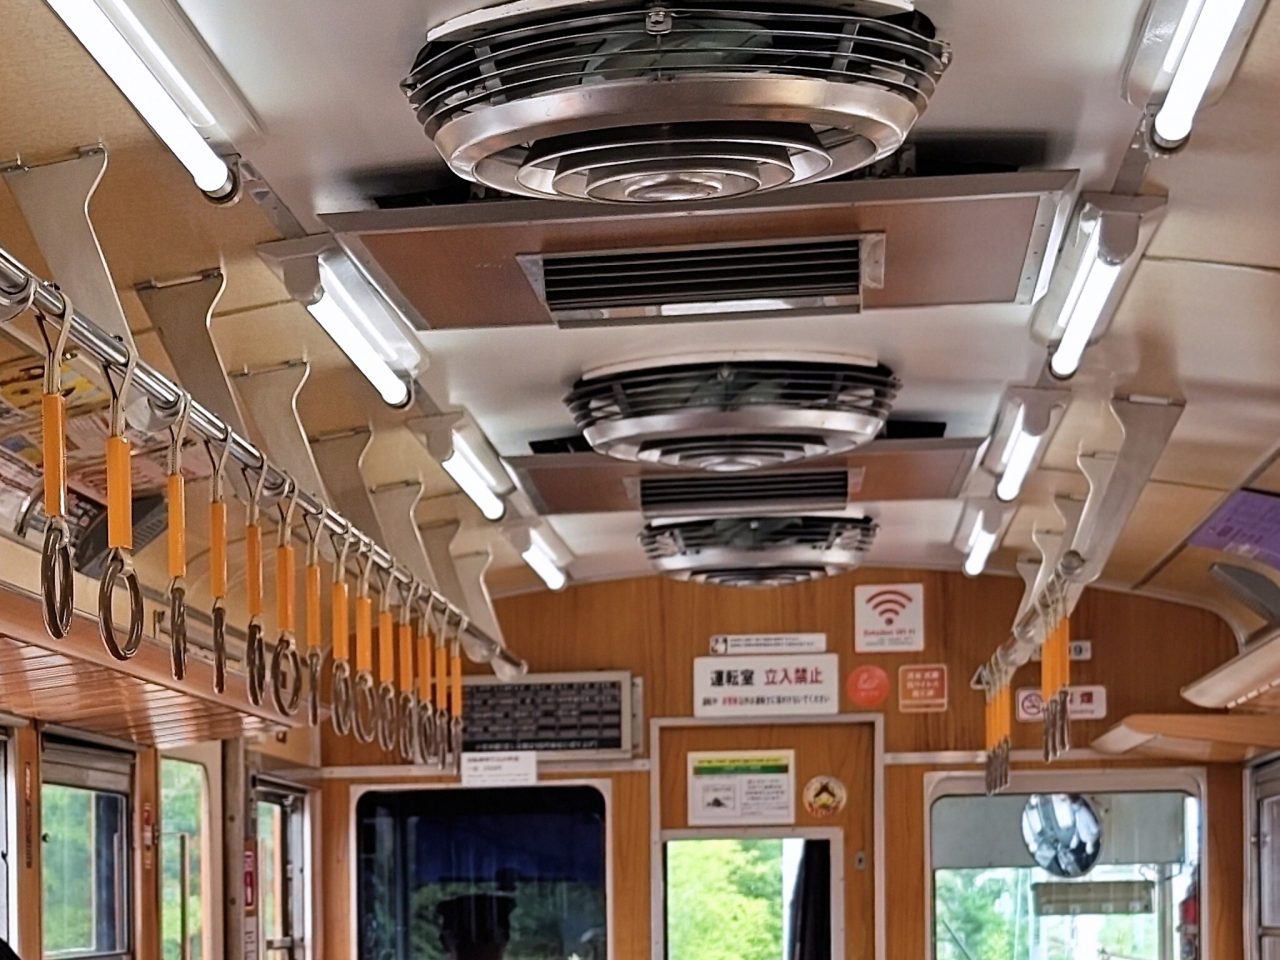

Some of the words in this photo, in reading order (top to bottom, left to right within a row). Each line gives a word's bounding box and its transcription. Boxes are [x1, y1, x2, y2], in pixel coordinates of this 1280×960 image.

[709, 669, 754, 687] 運転室
[764, 667, 824, 686] 立入禁止
